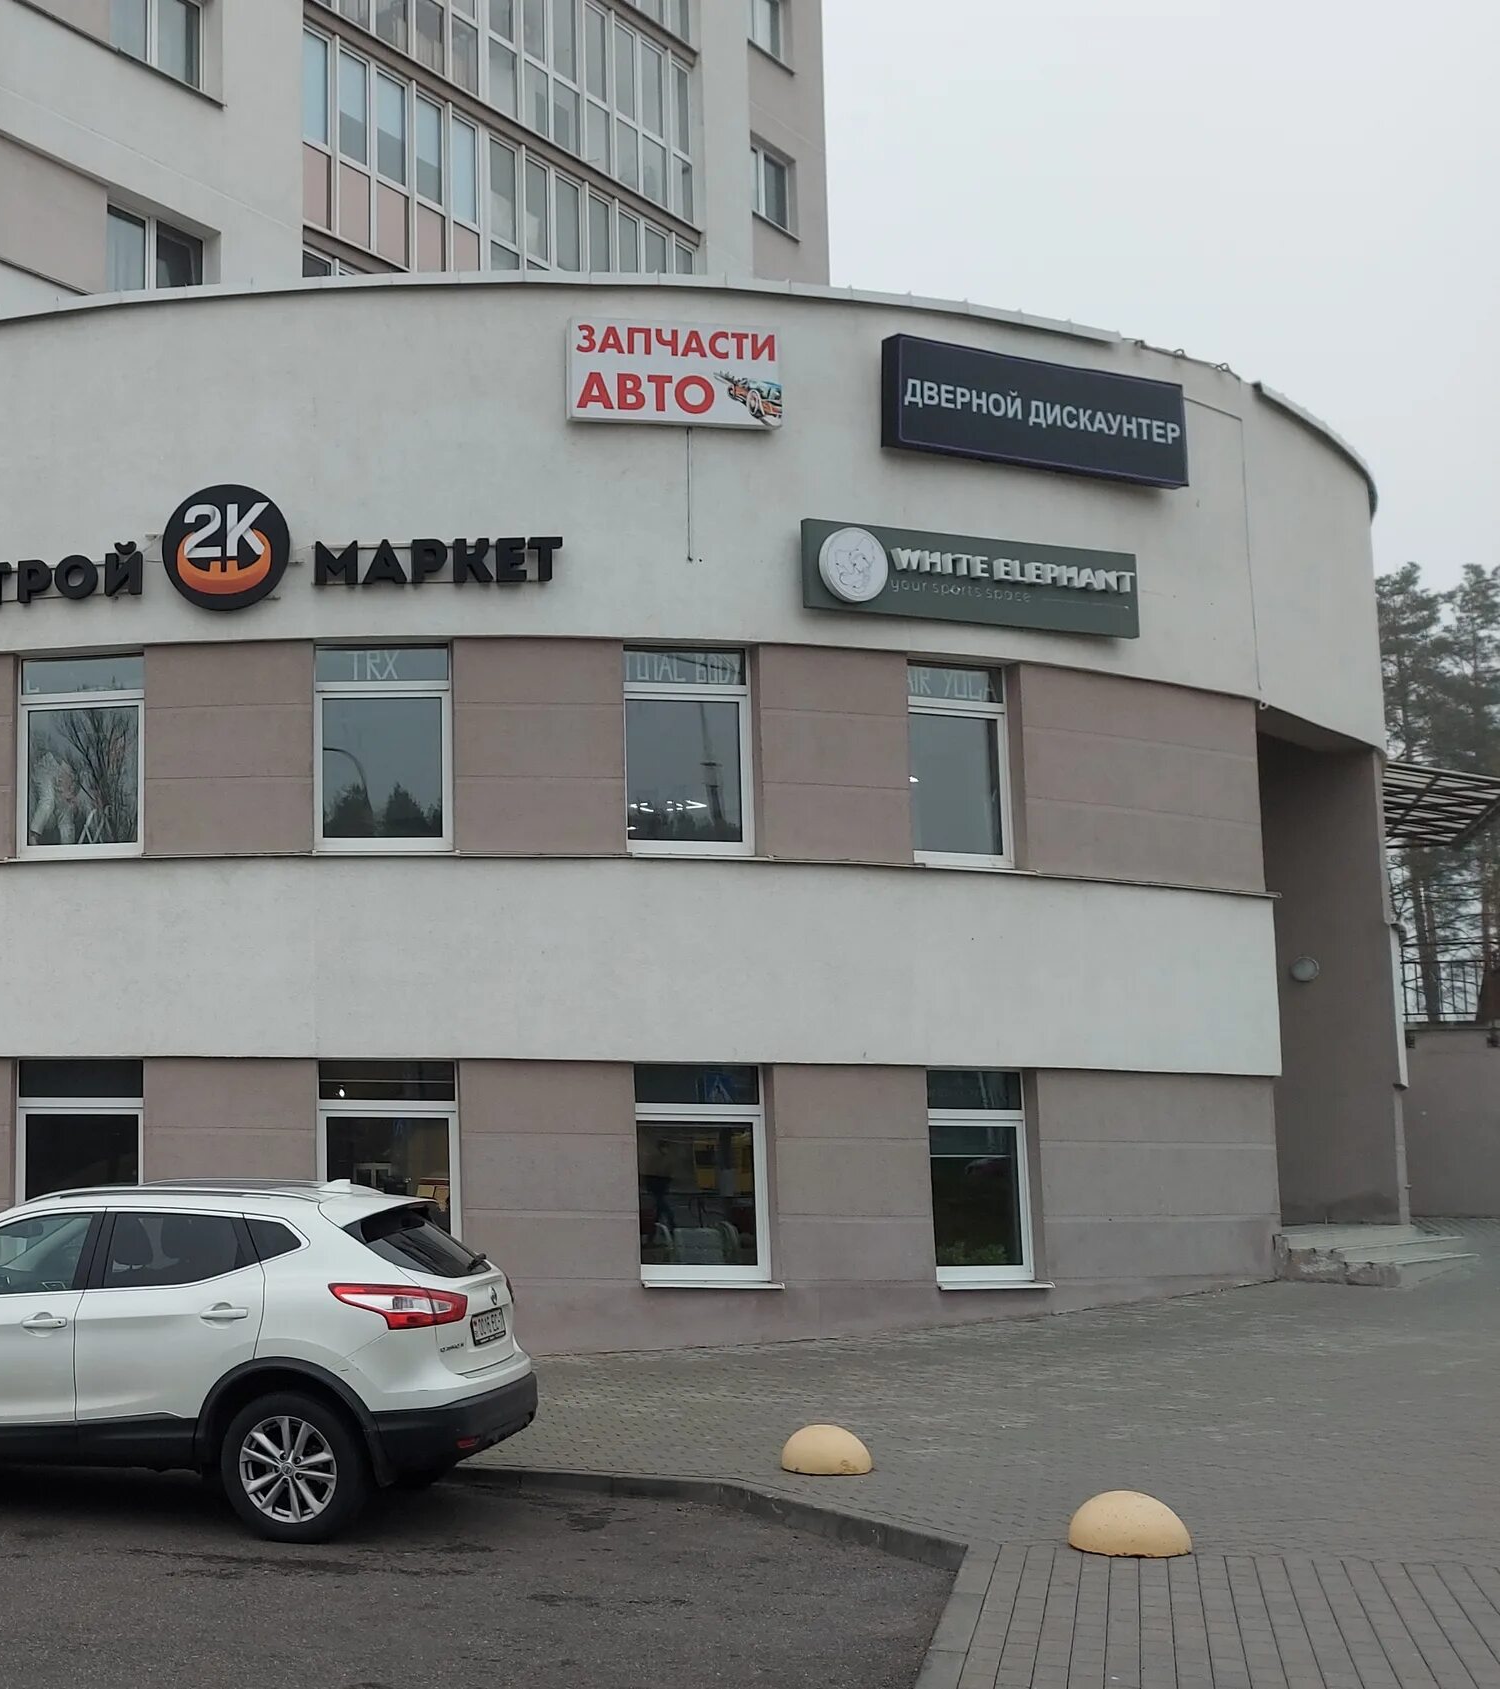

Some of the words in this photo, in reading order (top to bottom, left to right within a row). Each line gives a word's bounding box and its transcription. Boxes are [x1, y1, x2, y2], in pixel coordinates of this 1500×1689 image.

[576, 324, 776, 361] ЗАПЧАСТИ
[576, 372, 715, 414] АВТО
[904, 378, 1023, 420] ДВЕРНОЙ
[1028, 400, 1181, 444] ДИСКАУНТЕР
[313, 537, 564, 586] МАРКЕТ
[889, 547, 990, 579] WHITE
[993, 558, 1135, 594] ELEPHANT
[890, 579, 927, 594] your
[932, 582, 982, 598] sports
[986, 587, 1031, 603] space
[347, 650, 400, 680] TRX
